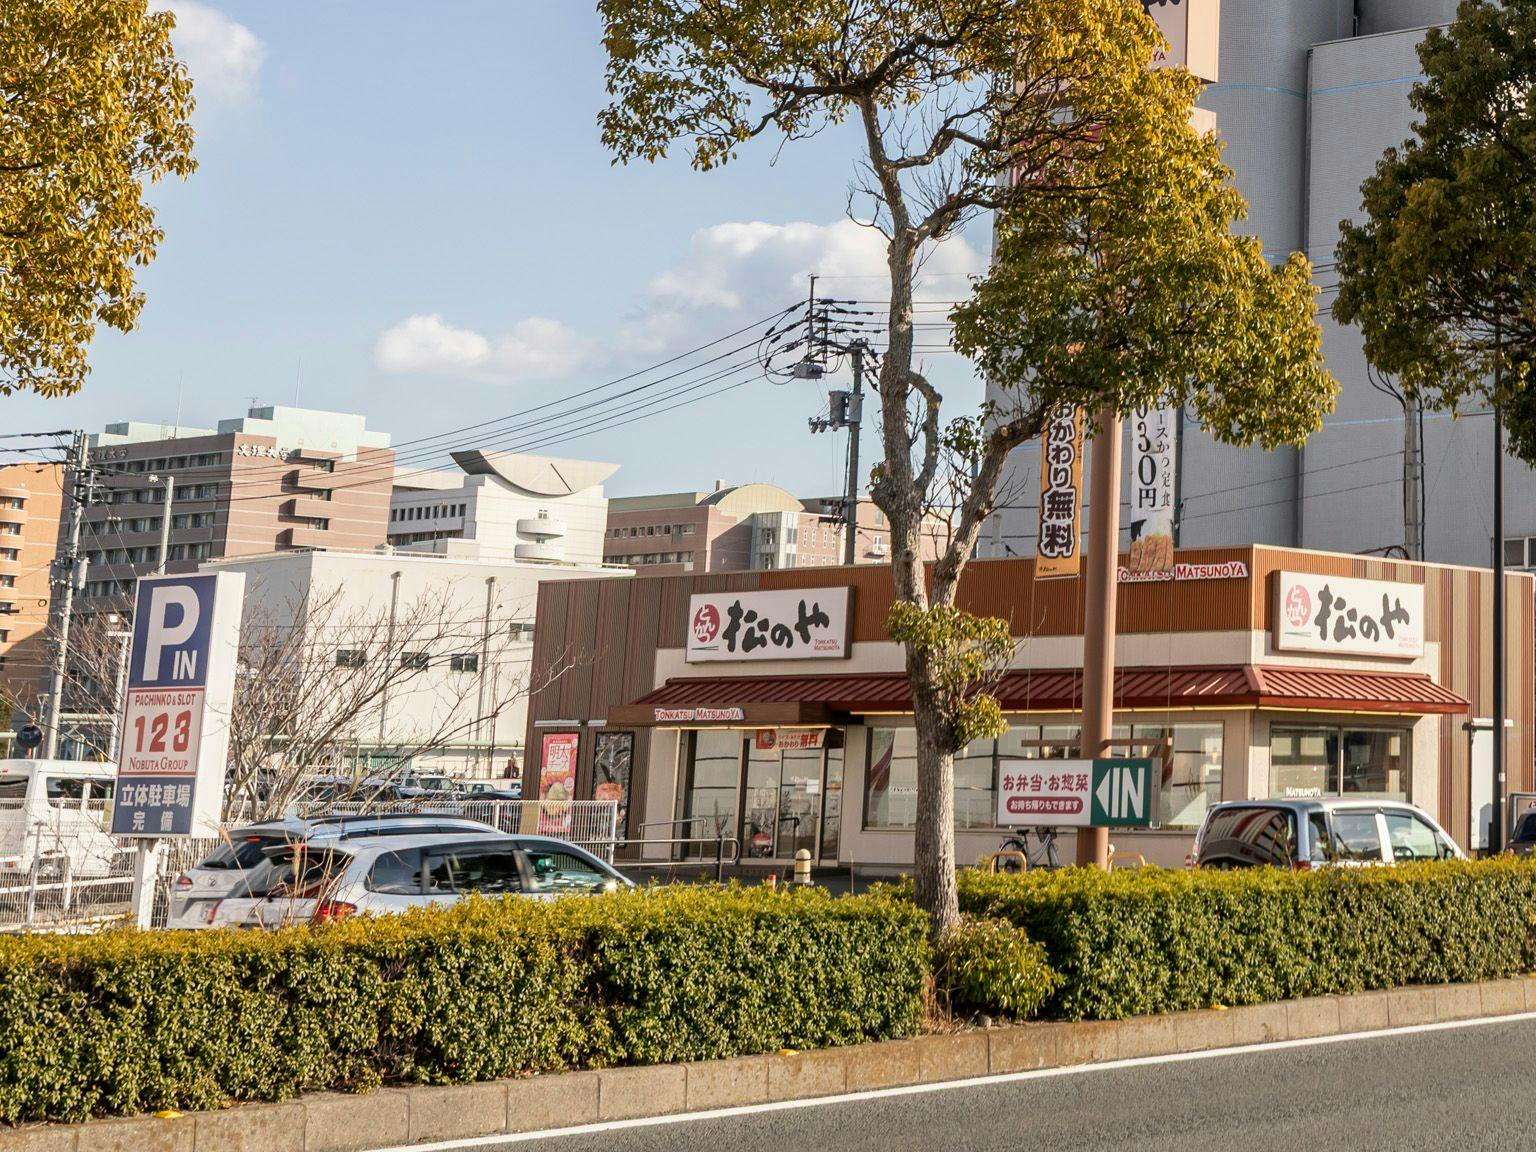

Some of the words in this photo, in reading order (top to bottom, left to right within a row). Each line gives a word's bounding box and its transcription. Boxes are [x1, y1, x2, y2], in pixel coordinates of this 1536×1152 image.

[1176, 564, 1244, 578] MATSUNOYA
[722, 600, 830, 652] 松のや
[1314, 584, 1410, 643] 松のや
[172, 650, 197, 680] IN
[135, 694, 171, 706] PACHINKO
[177, 694, 196, 705] SLOT
[655, 709, 693, 720] TONKATSU
[696, 708, 741, 720] MATSUNOYA
[135, 710, 192, 753] 123
[129, 757, 159, 770] NOBUTA
[160, 757, 189, 770] GROUP
[120, 784, 190, 807] 立体駐車場
[1111, 767, 1145, 819] IN
